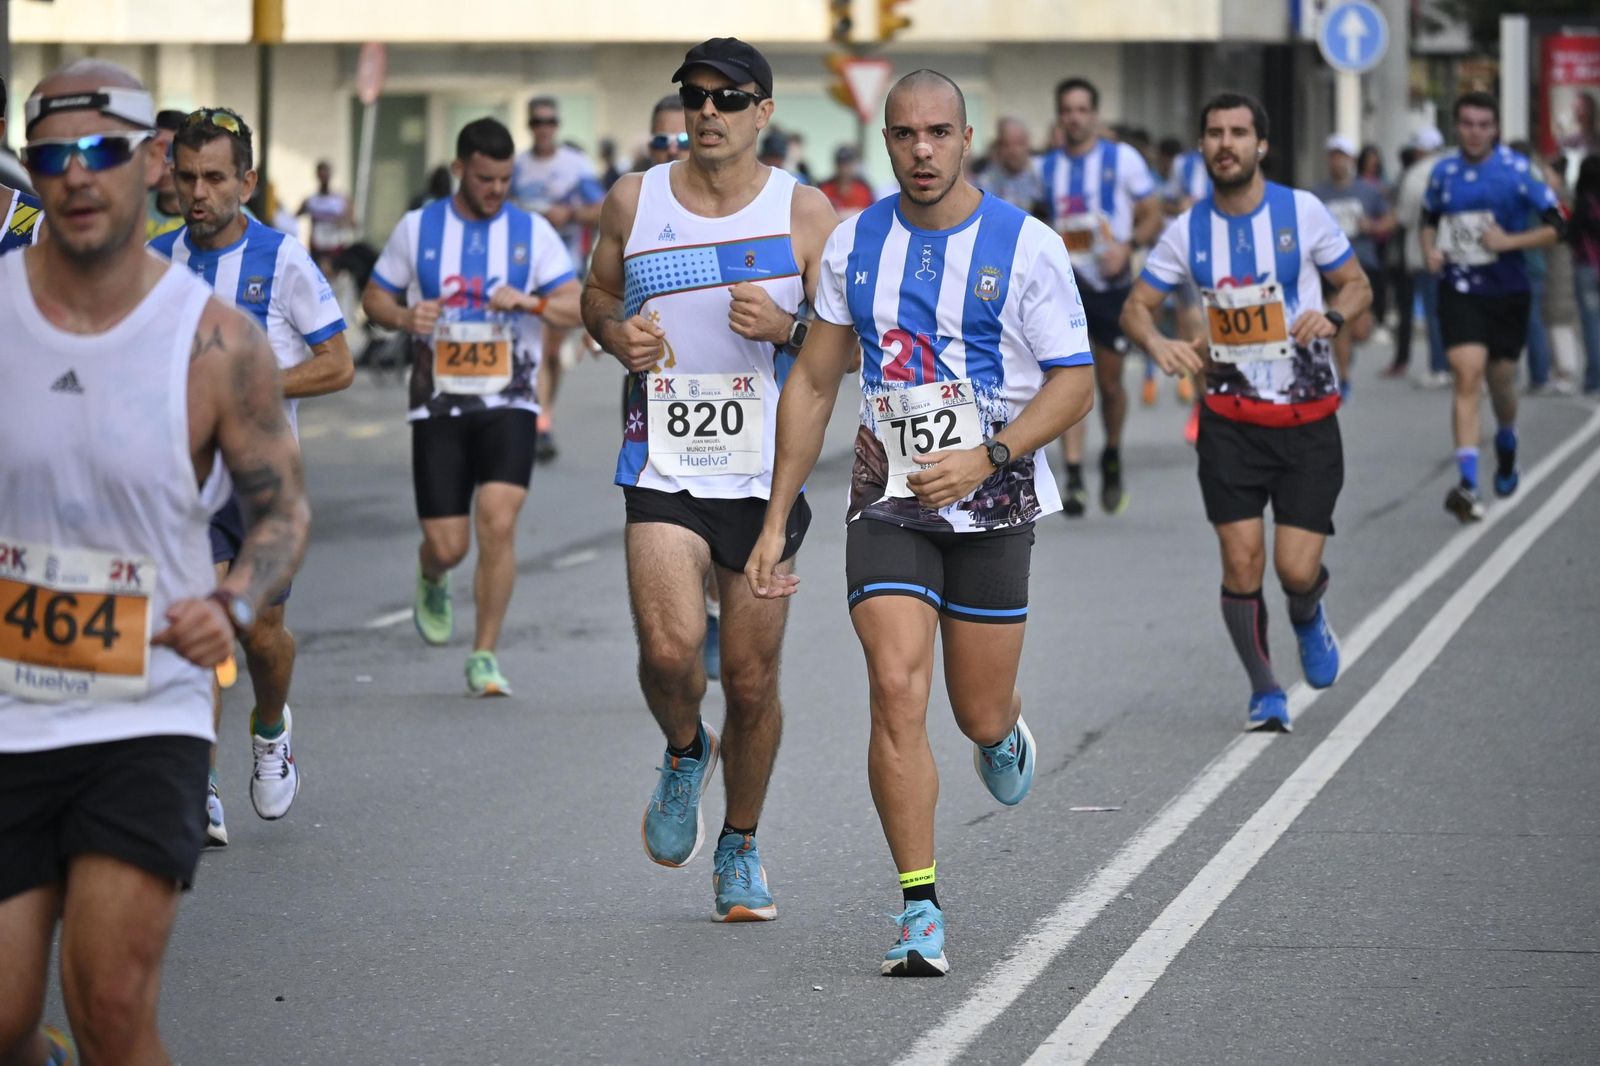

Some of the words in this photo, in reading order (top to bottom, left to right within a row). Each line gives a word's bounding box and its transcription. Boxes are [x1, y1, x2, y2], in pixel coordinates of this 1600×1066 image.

[1218, 305, 1268, 335] 301
[446, 342, 497, 366] 243
[943, 398, 967, 406] HUELVA
[667, 400, 744, 438] 820
[890, 409, 962, 457] 752
[680, 454, 728, 467] Huelva
[5, 584, 120, 650] 464
[15, 664, 90, 694] Huelva
